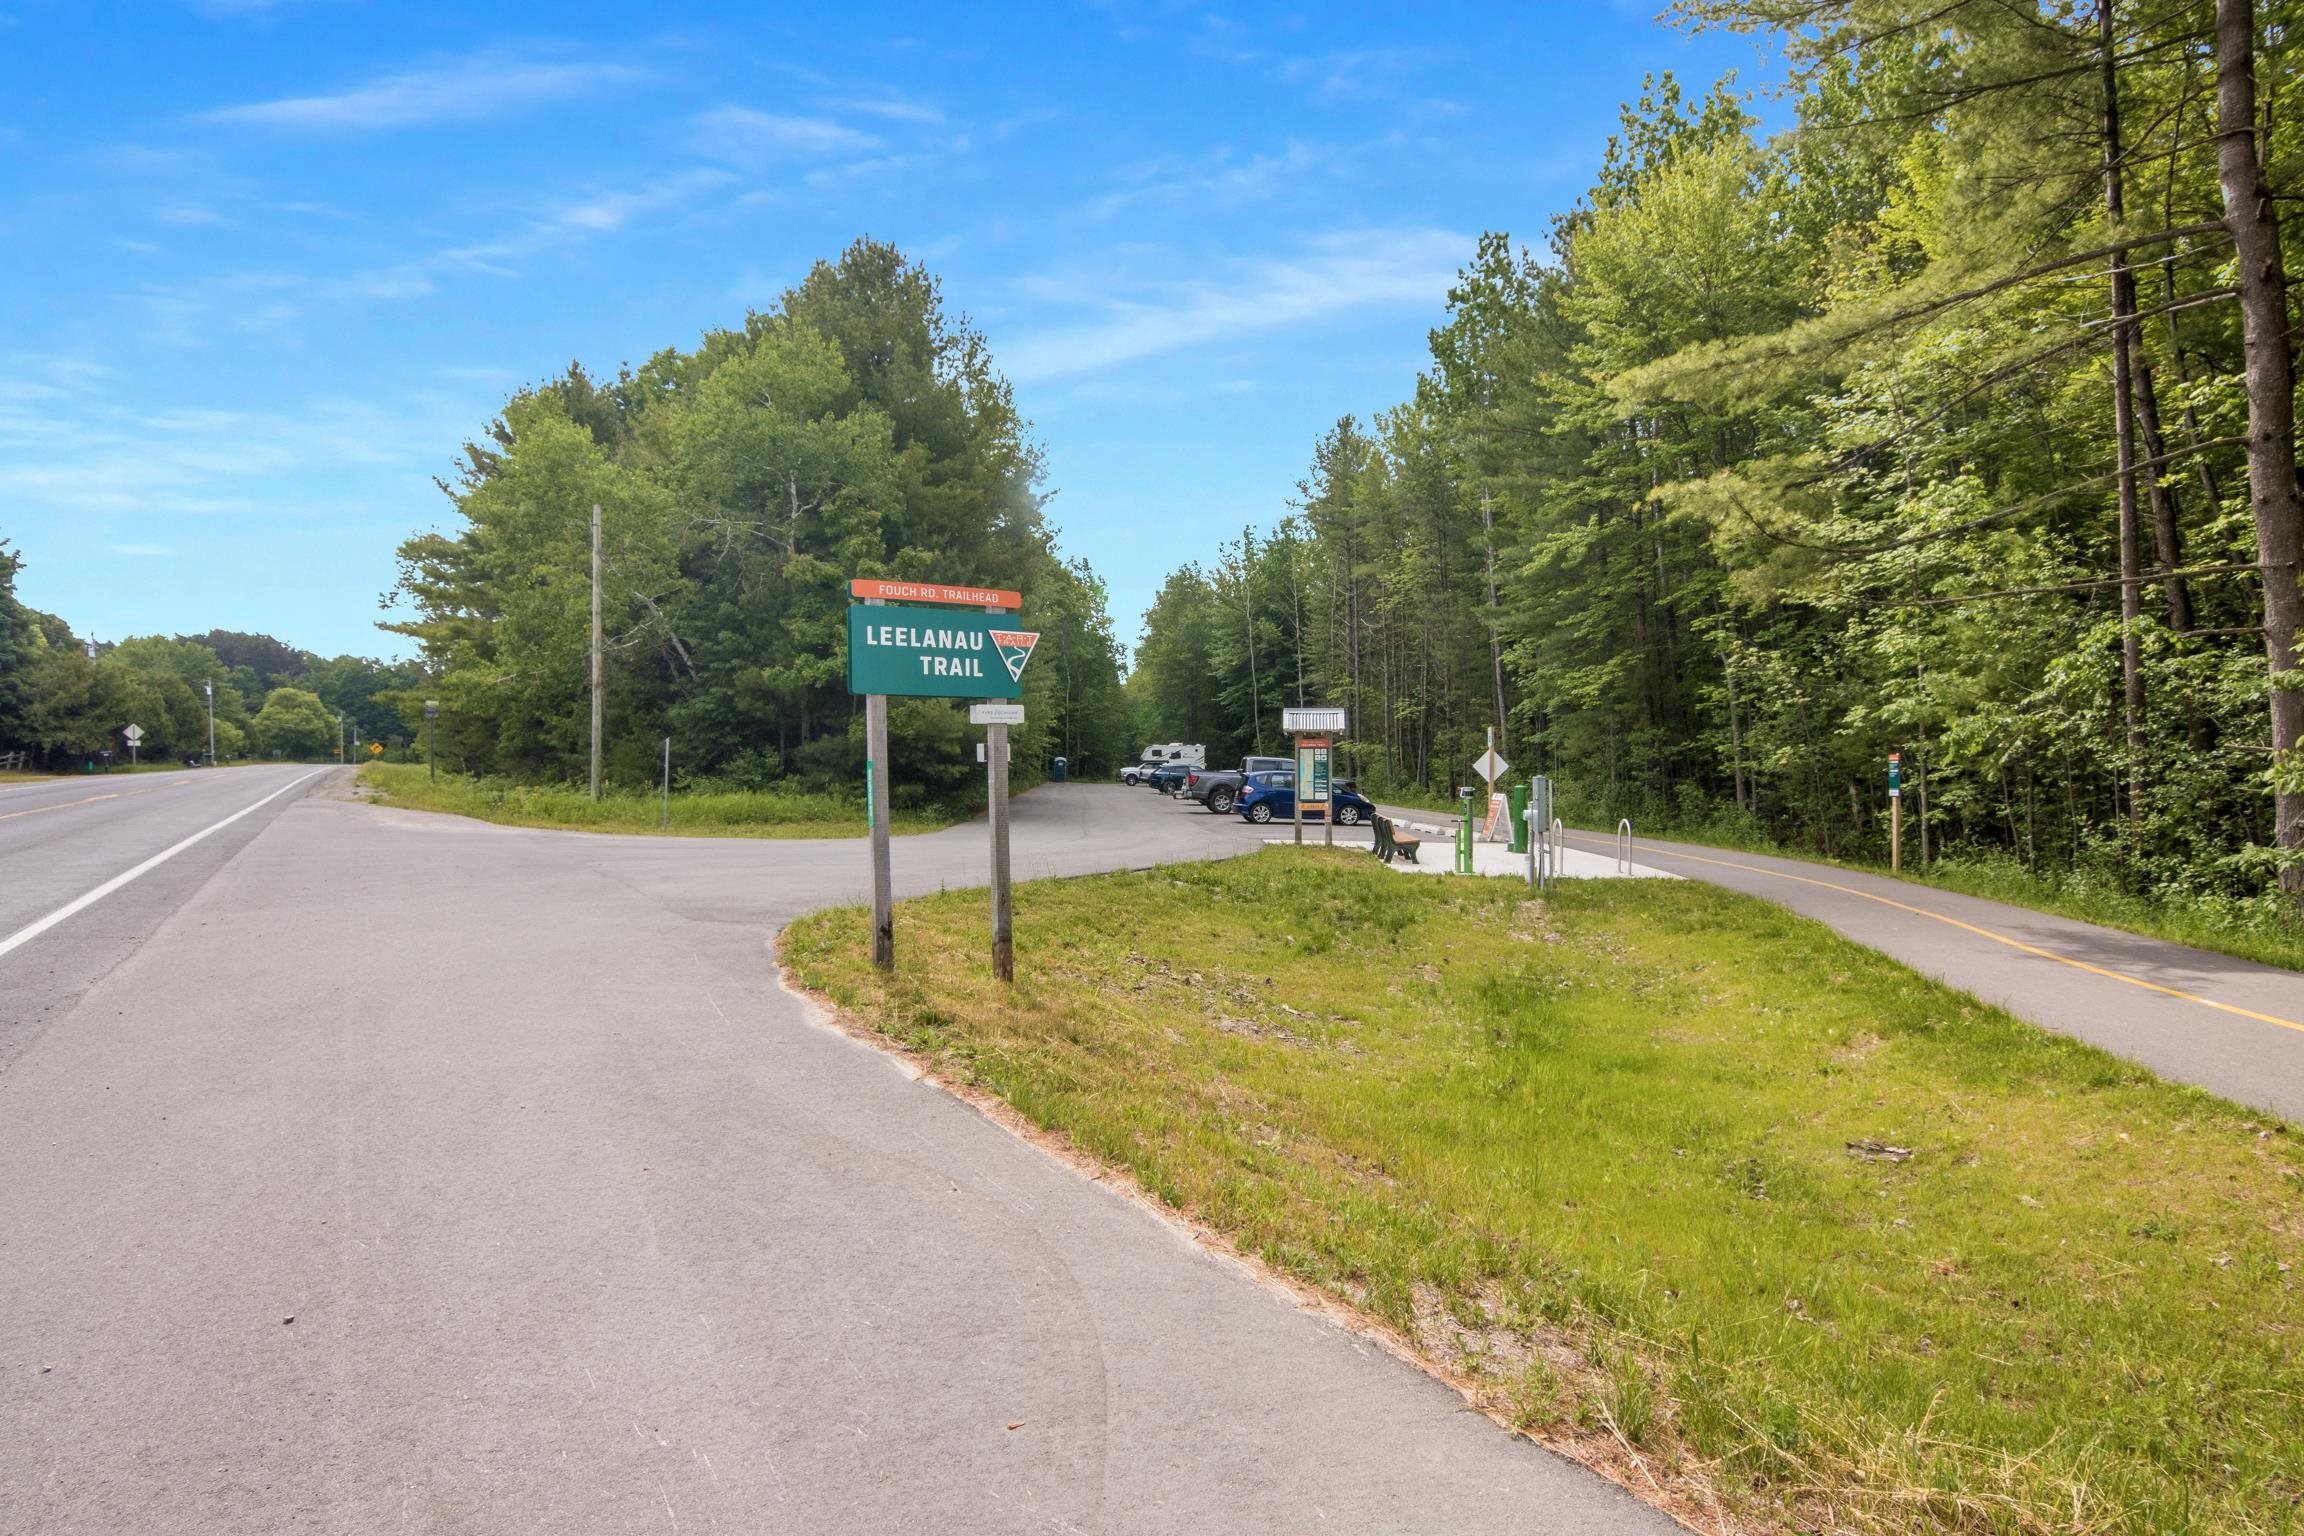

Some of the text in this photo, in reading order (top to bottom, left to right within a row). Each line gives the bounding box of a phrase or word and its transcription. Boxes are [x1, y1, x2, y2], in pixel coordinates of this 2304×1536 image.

[879, 584, 999, 603] FOUCH RD. TRAILHEAD
[866, 625, 983, 651] LEELANAU
[919, 655, 984, 677] TRAIL
